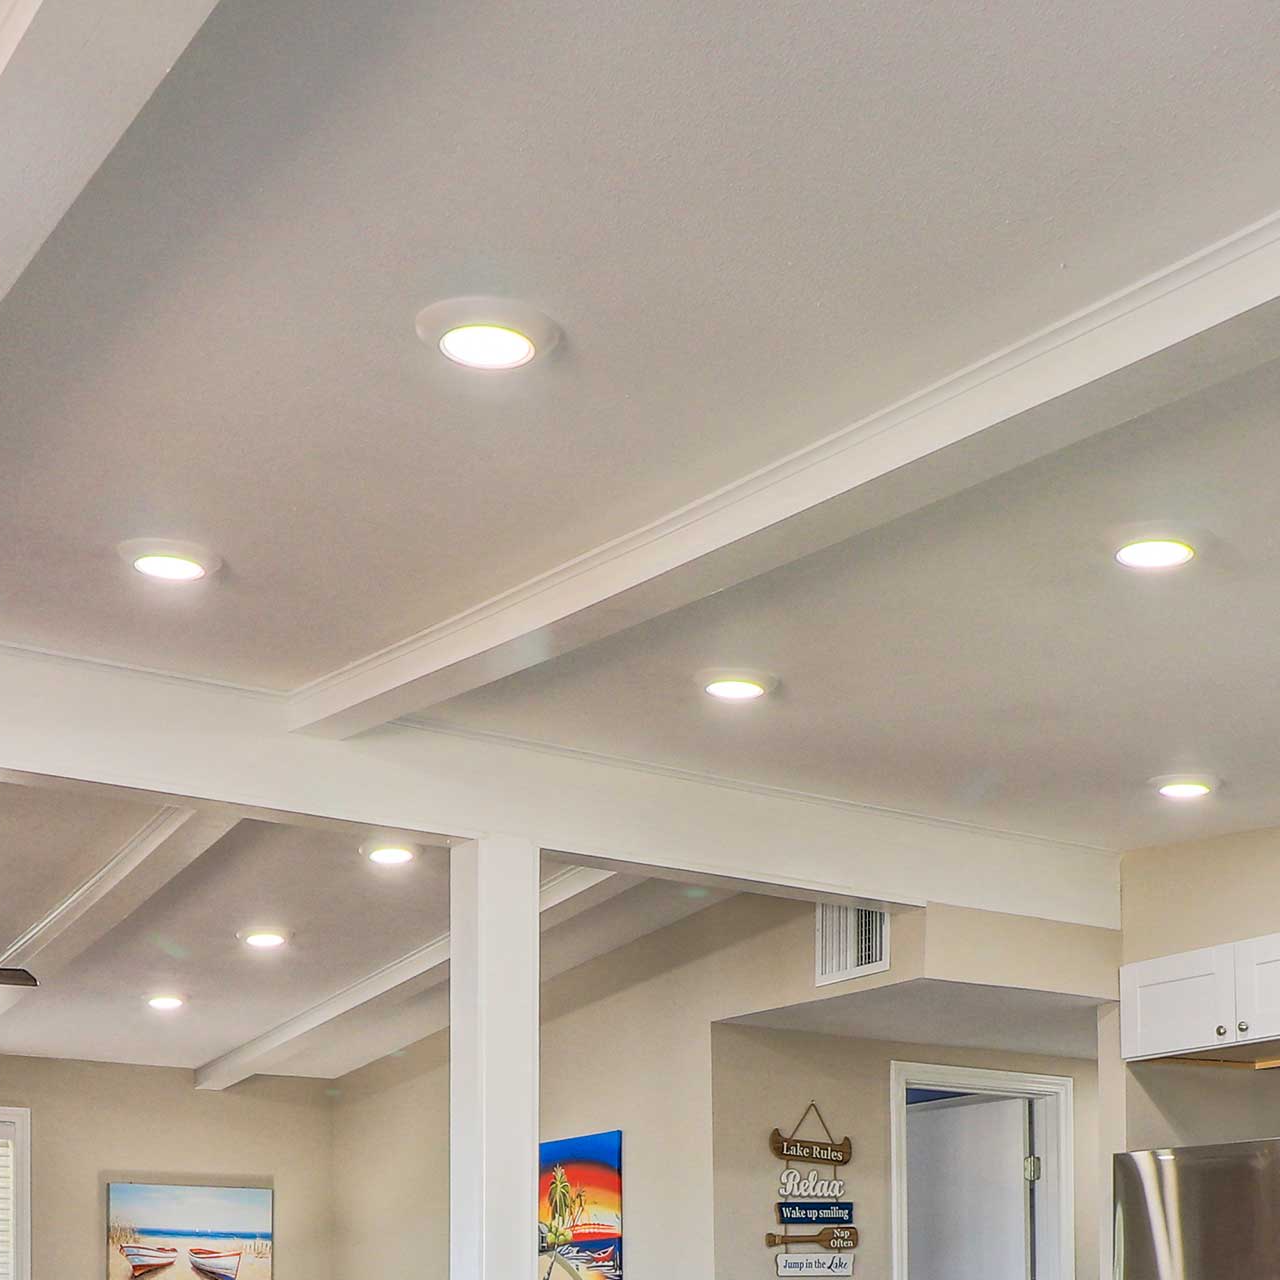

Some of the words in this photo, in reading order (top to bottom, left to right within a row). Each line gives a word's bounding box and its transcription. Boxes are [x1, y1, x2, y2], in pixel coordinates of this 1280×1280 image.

[783, 1142, 810, 1157] Lake
[812, 1145, 843, 1160] Rules
[779, 1168, 845, 1198] Relax
[782, 1206, 806, 1218] Wake
[807, 1208, 818, 1221] up
[819, 1206, 849, 1221] smiling
[833, 1229, 850, 1239] Nap
[830, 1238, 854, 1248] Often
[783, 1259, 805, 1272] Jump
[806, 1258, 814, 1269] in
[814, 1259, 826, 1269] the
[827, 1256, 848, 1273] Lake
